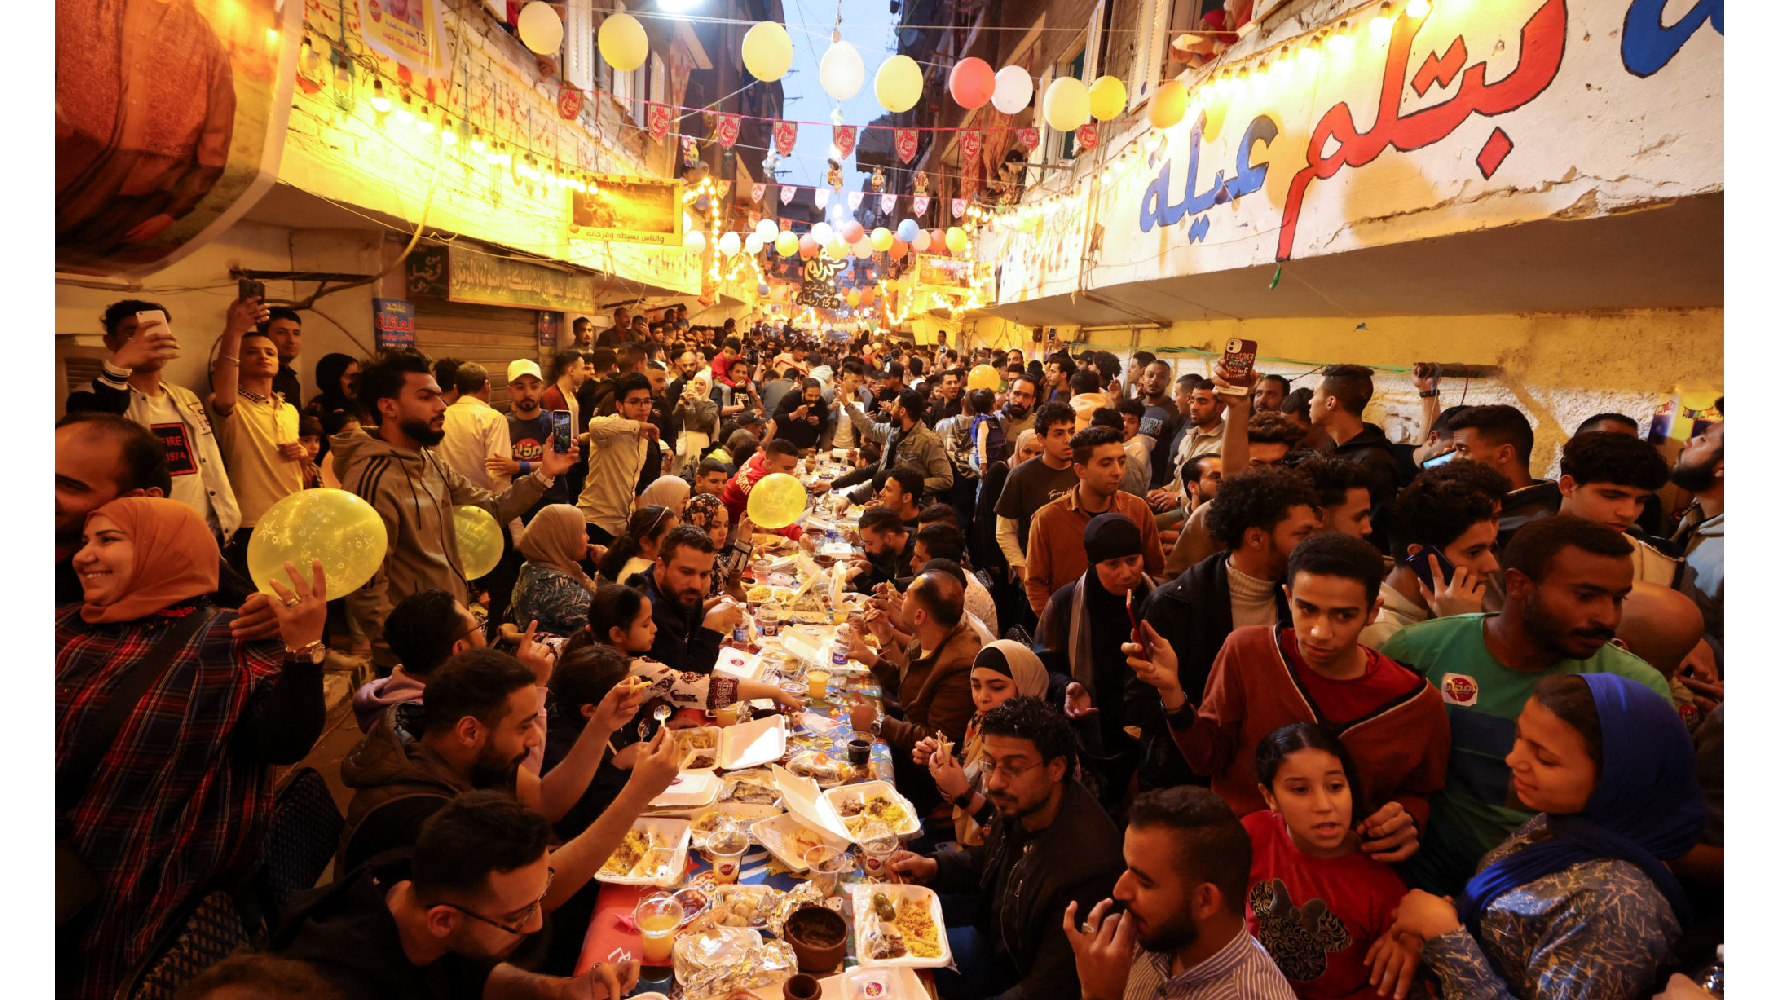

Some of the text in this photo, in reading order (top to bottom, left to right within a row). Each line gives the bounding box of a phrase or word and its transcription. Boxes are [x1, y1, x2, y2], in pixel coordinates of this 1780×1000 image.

[1277, 0, 1567, 262] بتلم
[822, 298, 830, 307] 15
[375, 312, 414, 332] العائلة
